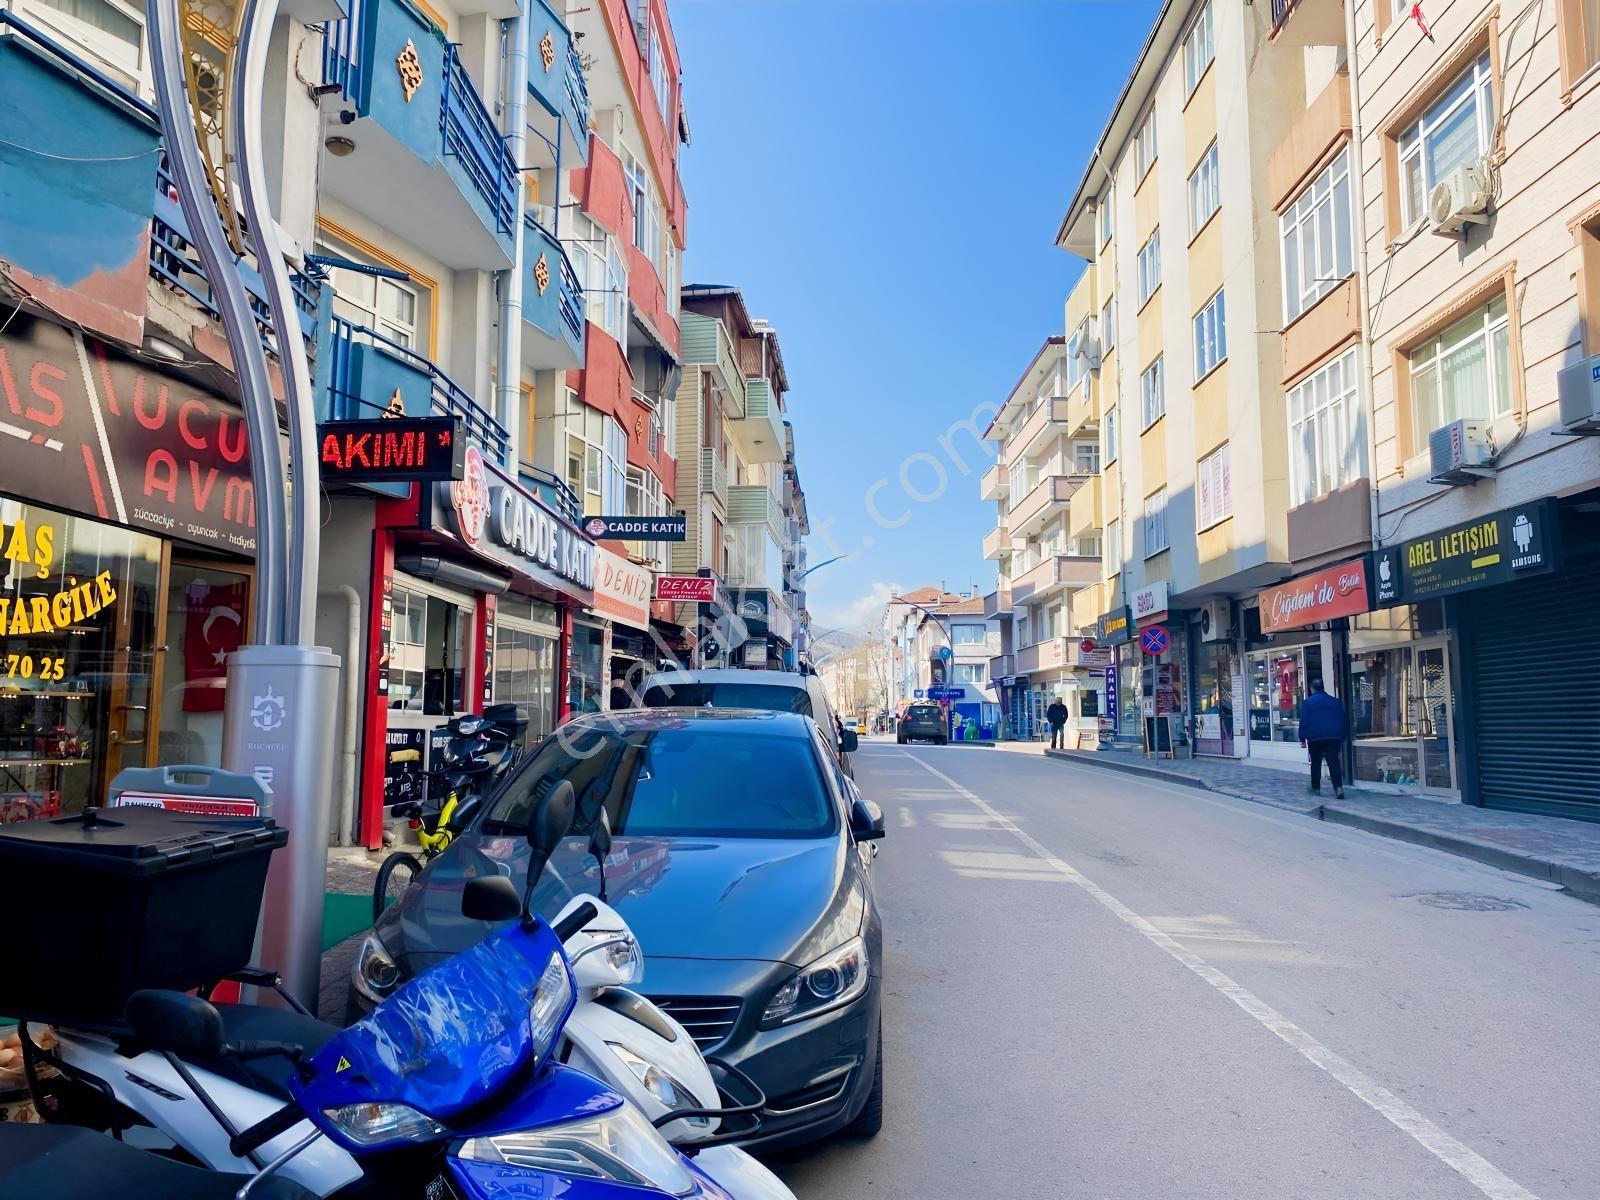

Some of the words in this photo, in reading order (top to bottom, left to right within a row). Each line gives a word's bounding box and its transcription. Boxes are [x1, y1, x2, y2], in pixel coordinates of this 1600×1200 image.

[0, 519, 53, 579] AŞ
[500, 486, 558, 570] CADDE
[608, 522, 649, 533] CADDE
[651, 523, 685, 533] KATIK
[1408, 540, 1438, 568] AREL
[1440, 520, 1499, 560] İLETİŞİM
[603, 562, 647, 601] DENİZ
[7, 655, 33, 679] 70
[40, 657, 65, 680] 25
